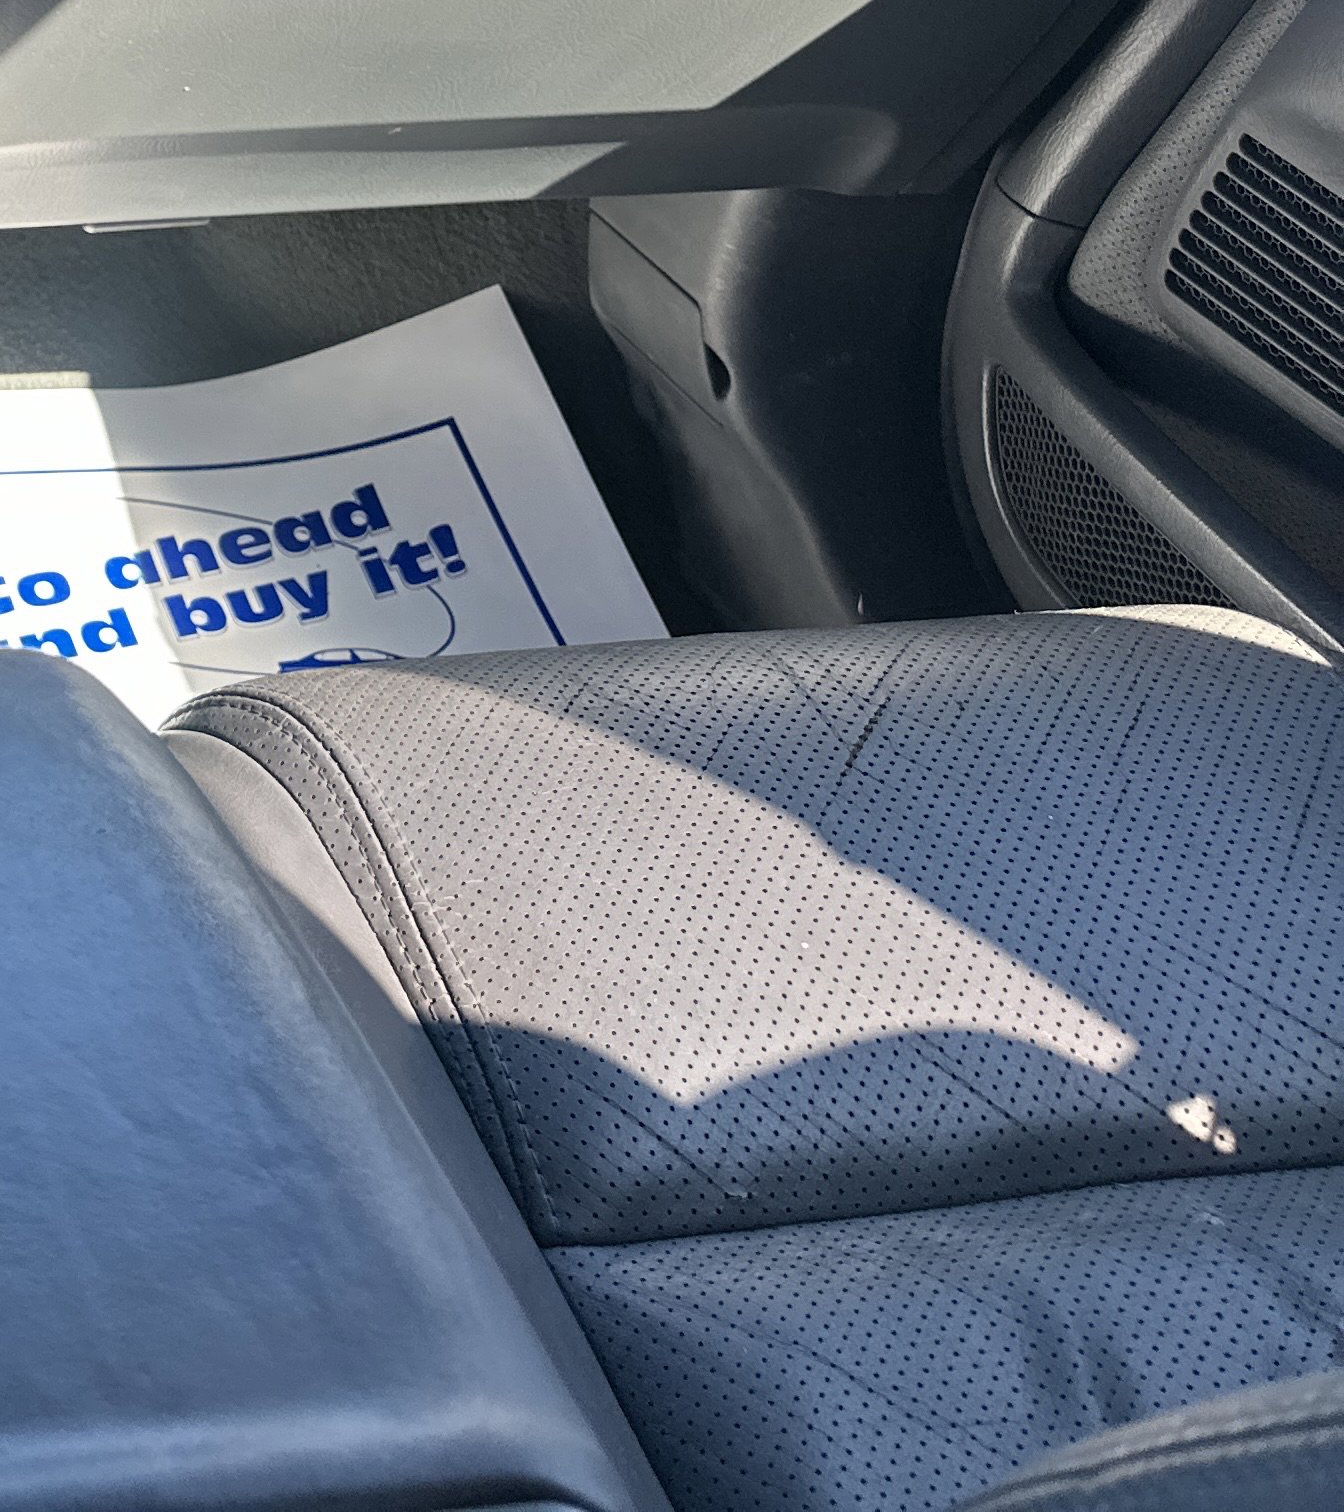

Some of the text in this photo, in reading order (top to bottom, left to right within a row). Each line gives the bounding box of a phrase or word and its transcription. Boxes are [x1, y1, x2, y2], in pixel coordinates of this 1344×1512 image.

[104, 483, 392, 590] ahead
[162, 570, 330, 642] buy
[359, 524, 468, 599] it!
